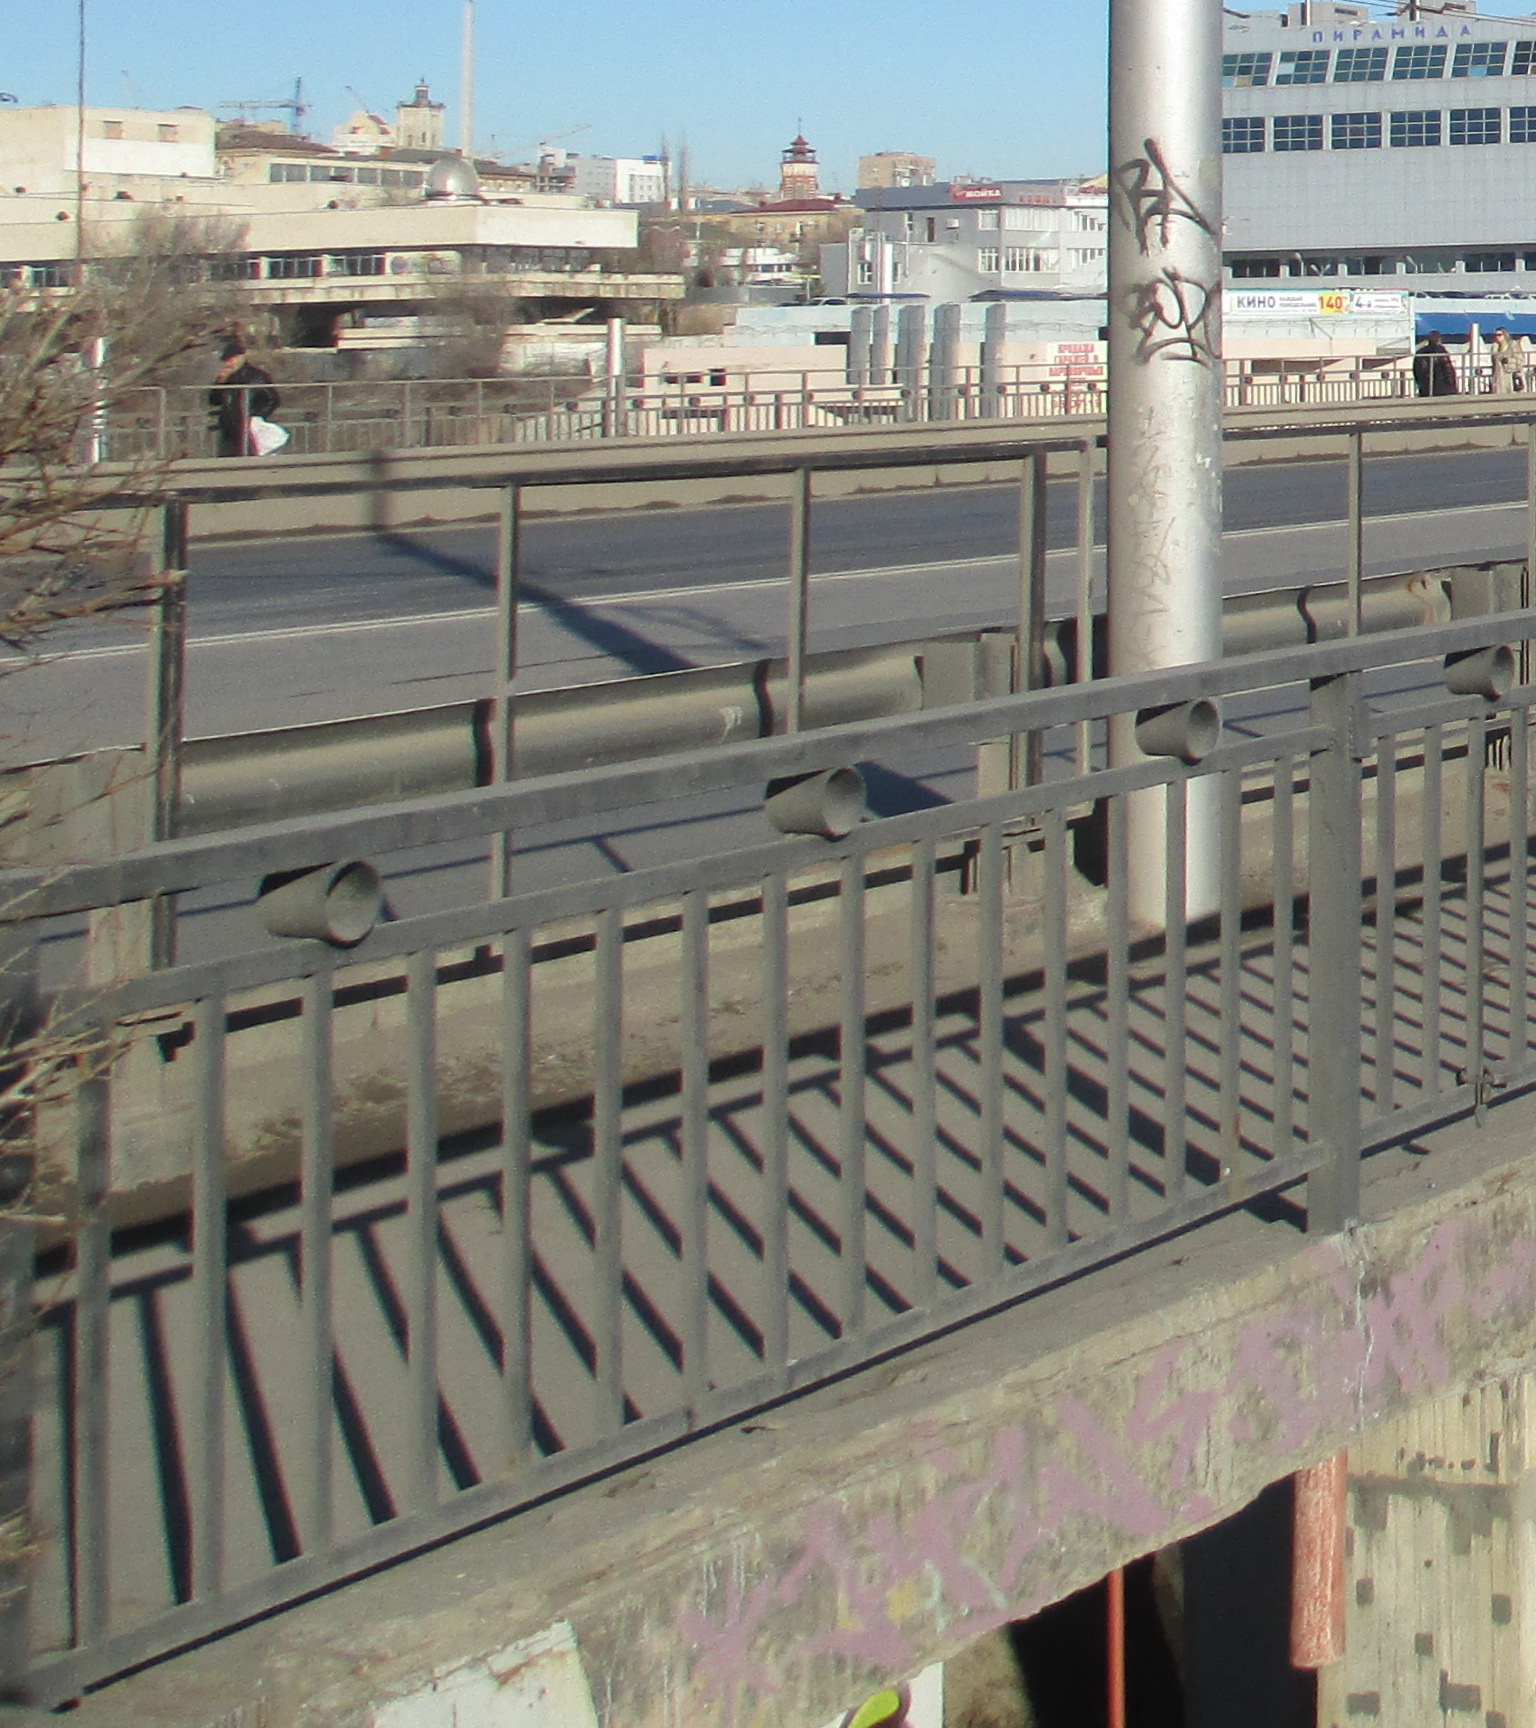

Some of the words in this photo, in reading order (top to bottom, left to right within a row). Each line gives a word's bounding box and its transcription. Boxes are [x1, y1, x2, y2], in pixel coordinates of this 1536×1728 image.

[1312, 25, 1473, 43] ПИРАМИДА
[1237, 295, 1277, 309] КИНО
[1319, 295, 1343, 309] 140
